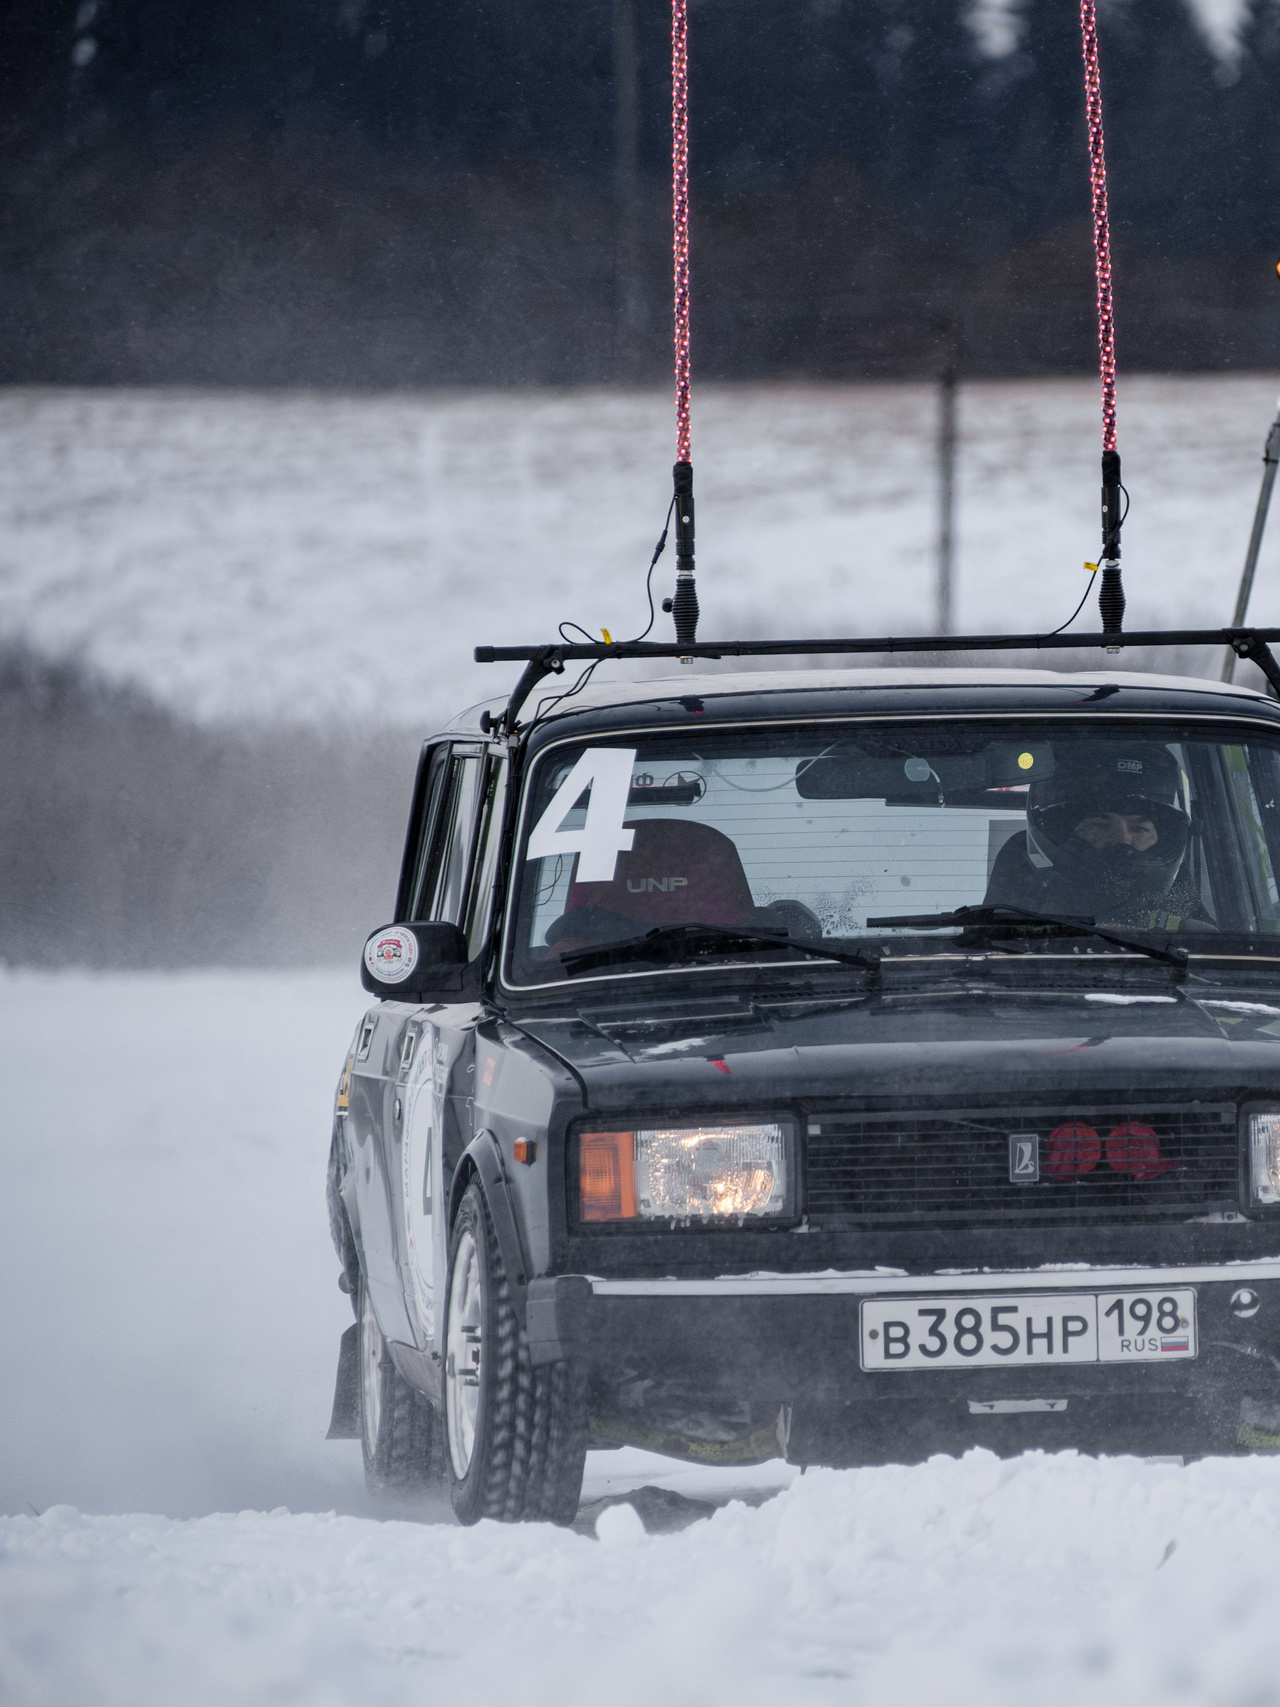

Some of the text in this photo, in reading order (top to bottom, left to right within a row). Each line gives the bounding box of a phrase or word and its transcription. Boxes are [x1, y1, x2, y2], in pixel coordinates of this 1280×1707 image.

[1117, 761, 1143, 771] OMP
[527, 748, 637, 883] 4
[626, 877, 688, 893] UNP
[1103, 1296, 1181, 1338] 198
[1120, 1337, 1159, 1353] RUS
